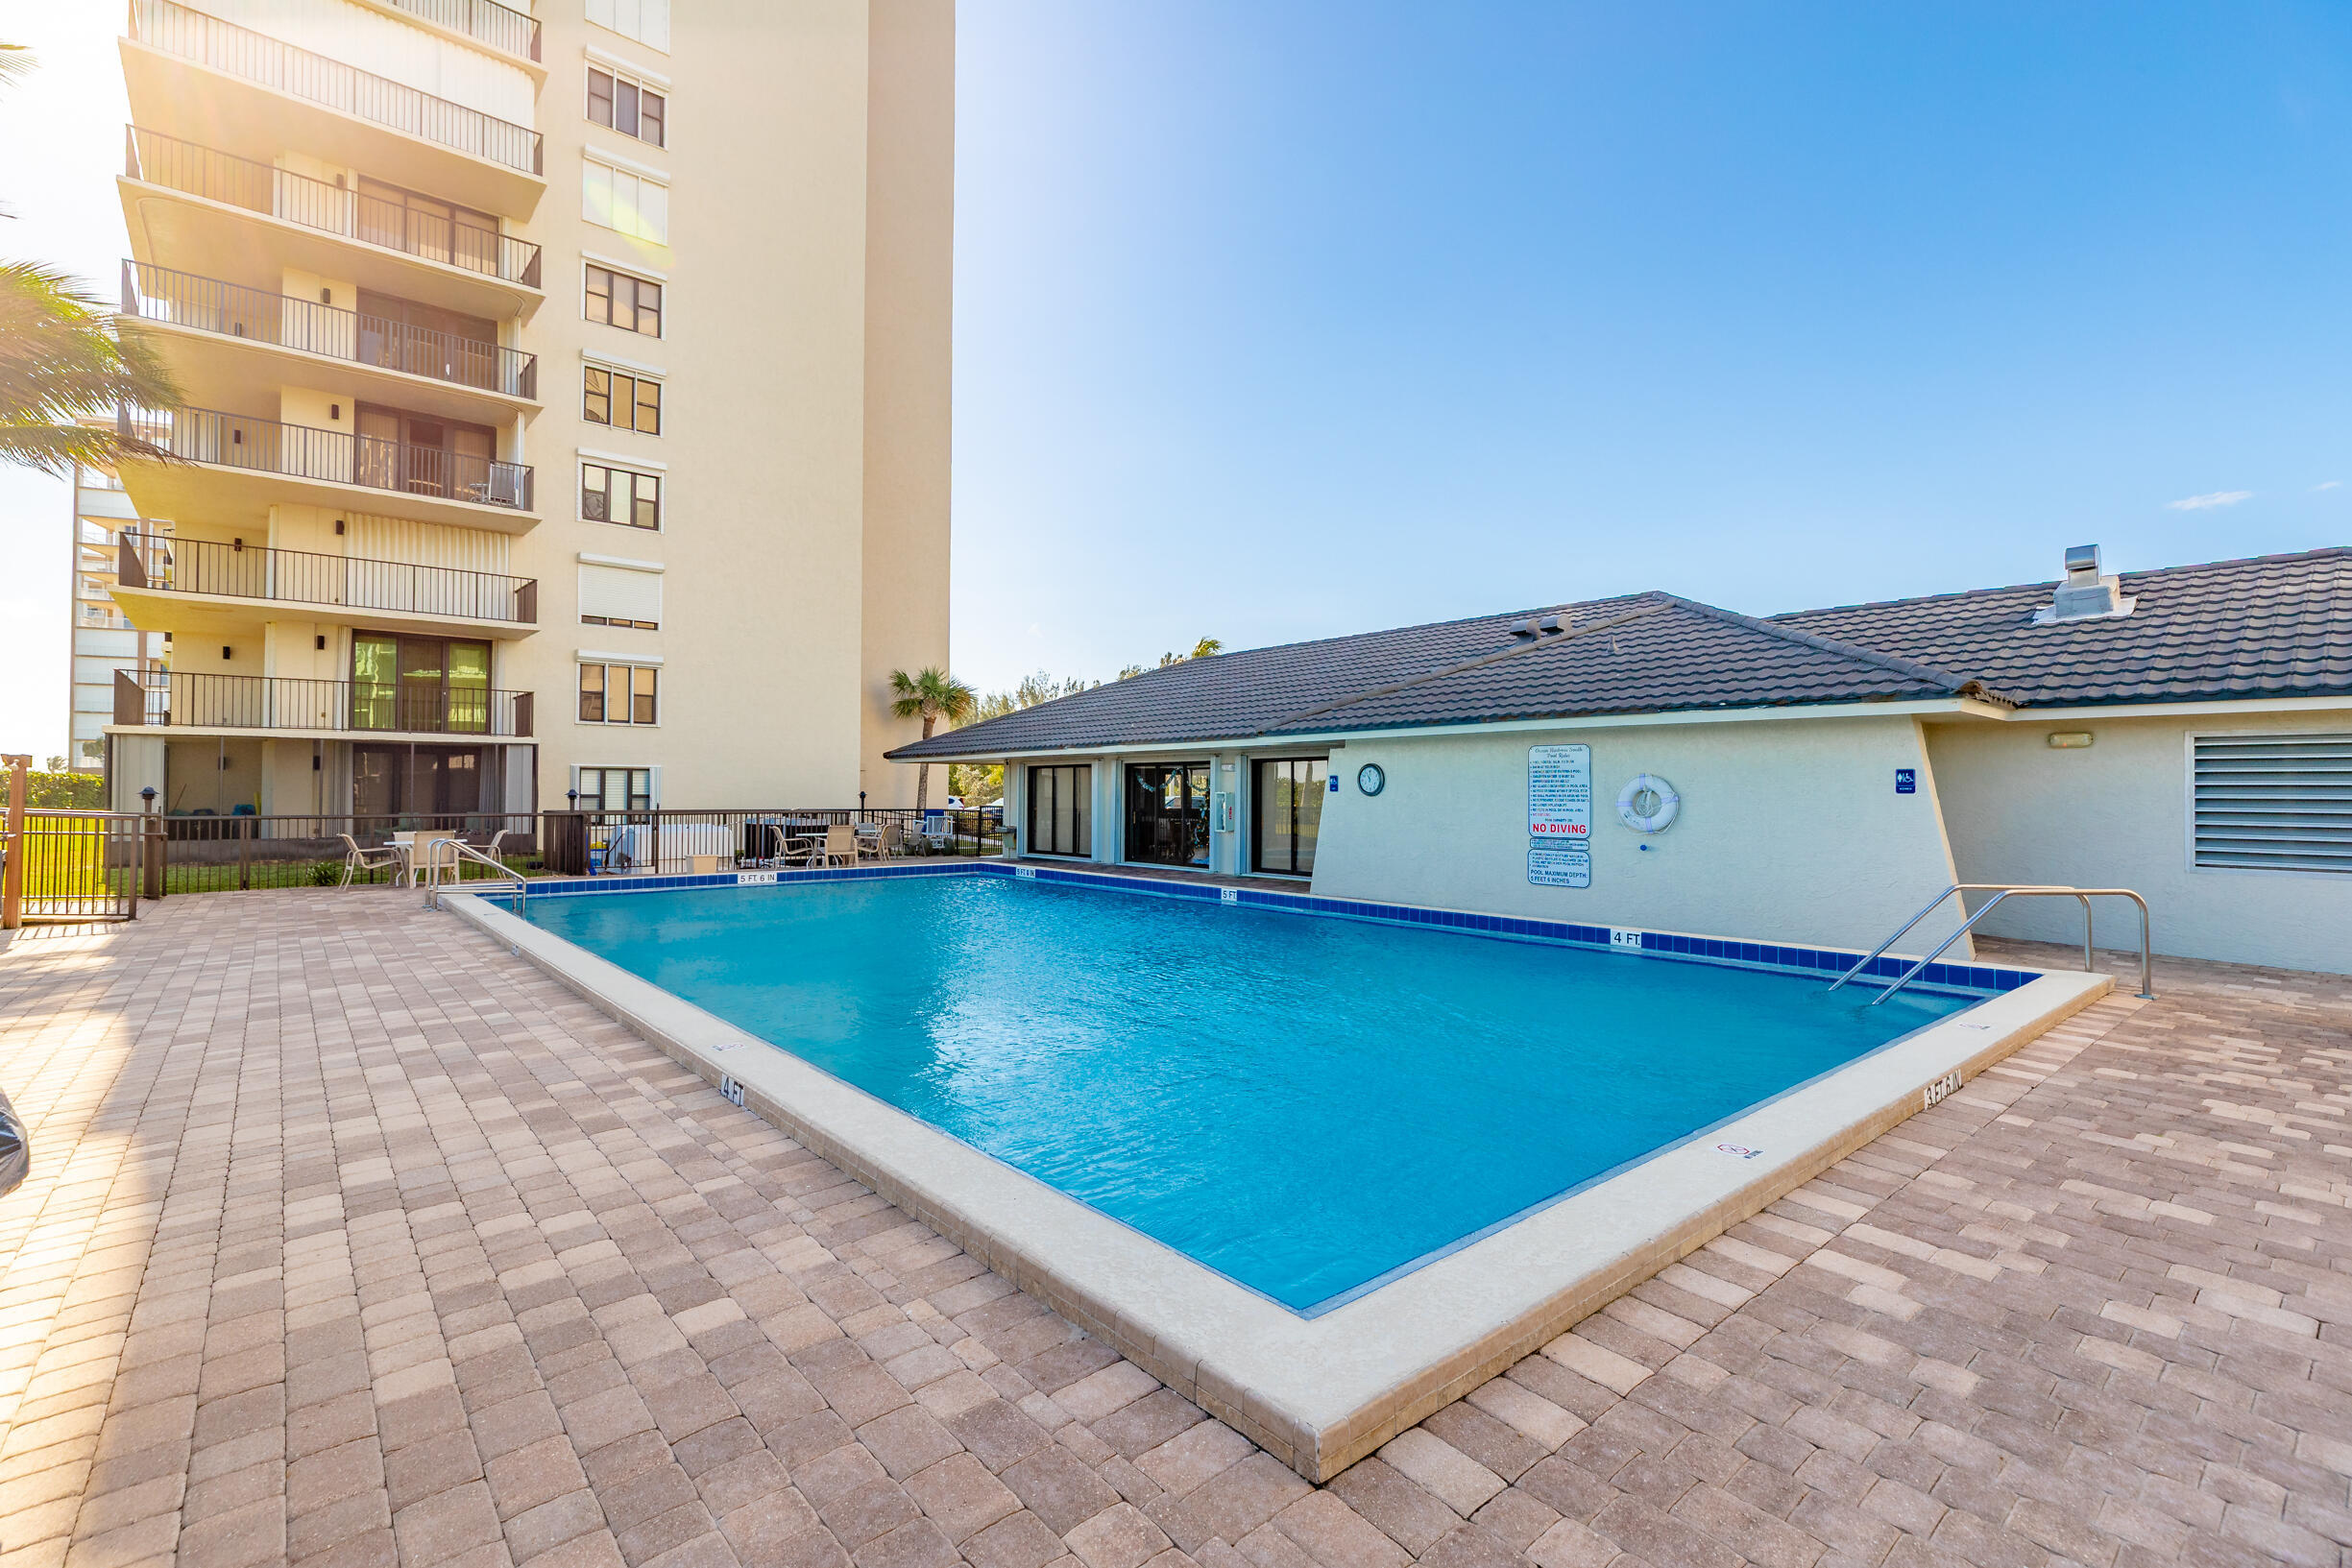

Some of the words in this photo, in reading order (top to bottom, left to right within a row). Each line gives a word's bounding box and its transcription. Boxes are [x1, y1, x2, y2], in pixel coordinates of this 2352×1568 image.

[1533, 823, 1547, 832] NO
[1550, 824, 1587, 833] DIVING
[1613, 932, 1621, 943] 4
[1626, 933, 1640, 946] FT.
[722, 1076, 730, 1099] 4
[1927, 1087, 1932, 1106] 3
[1946, 1075, 1951, 1095] 6
